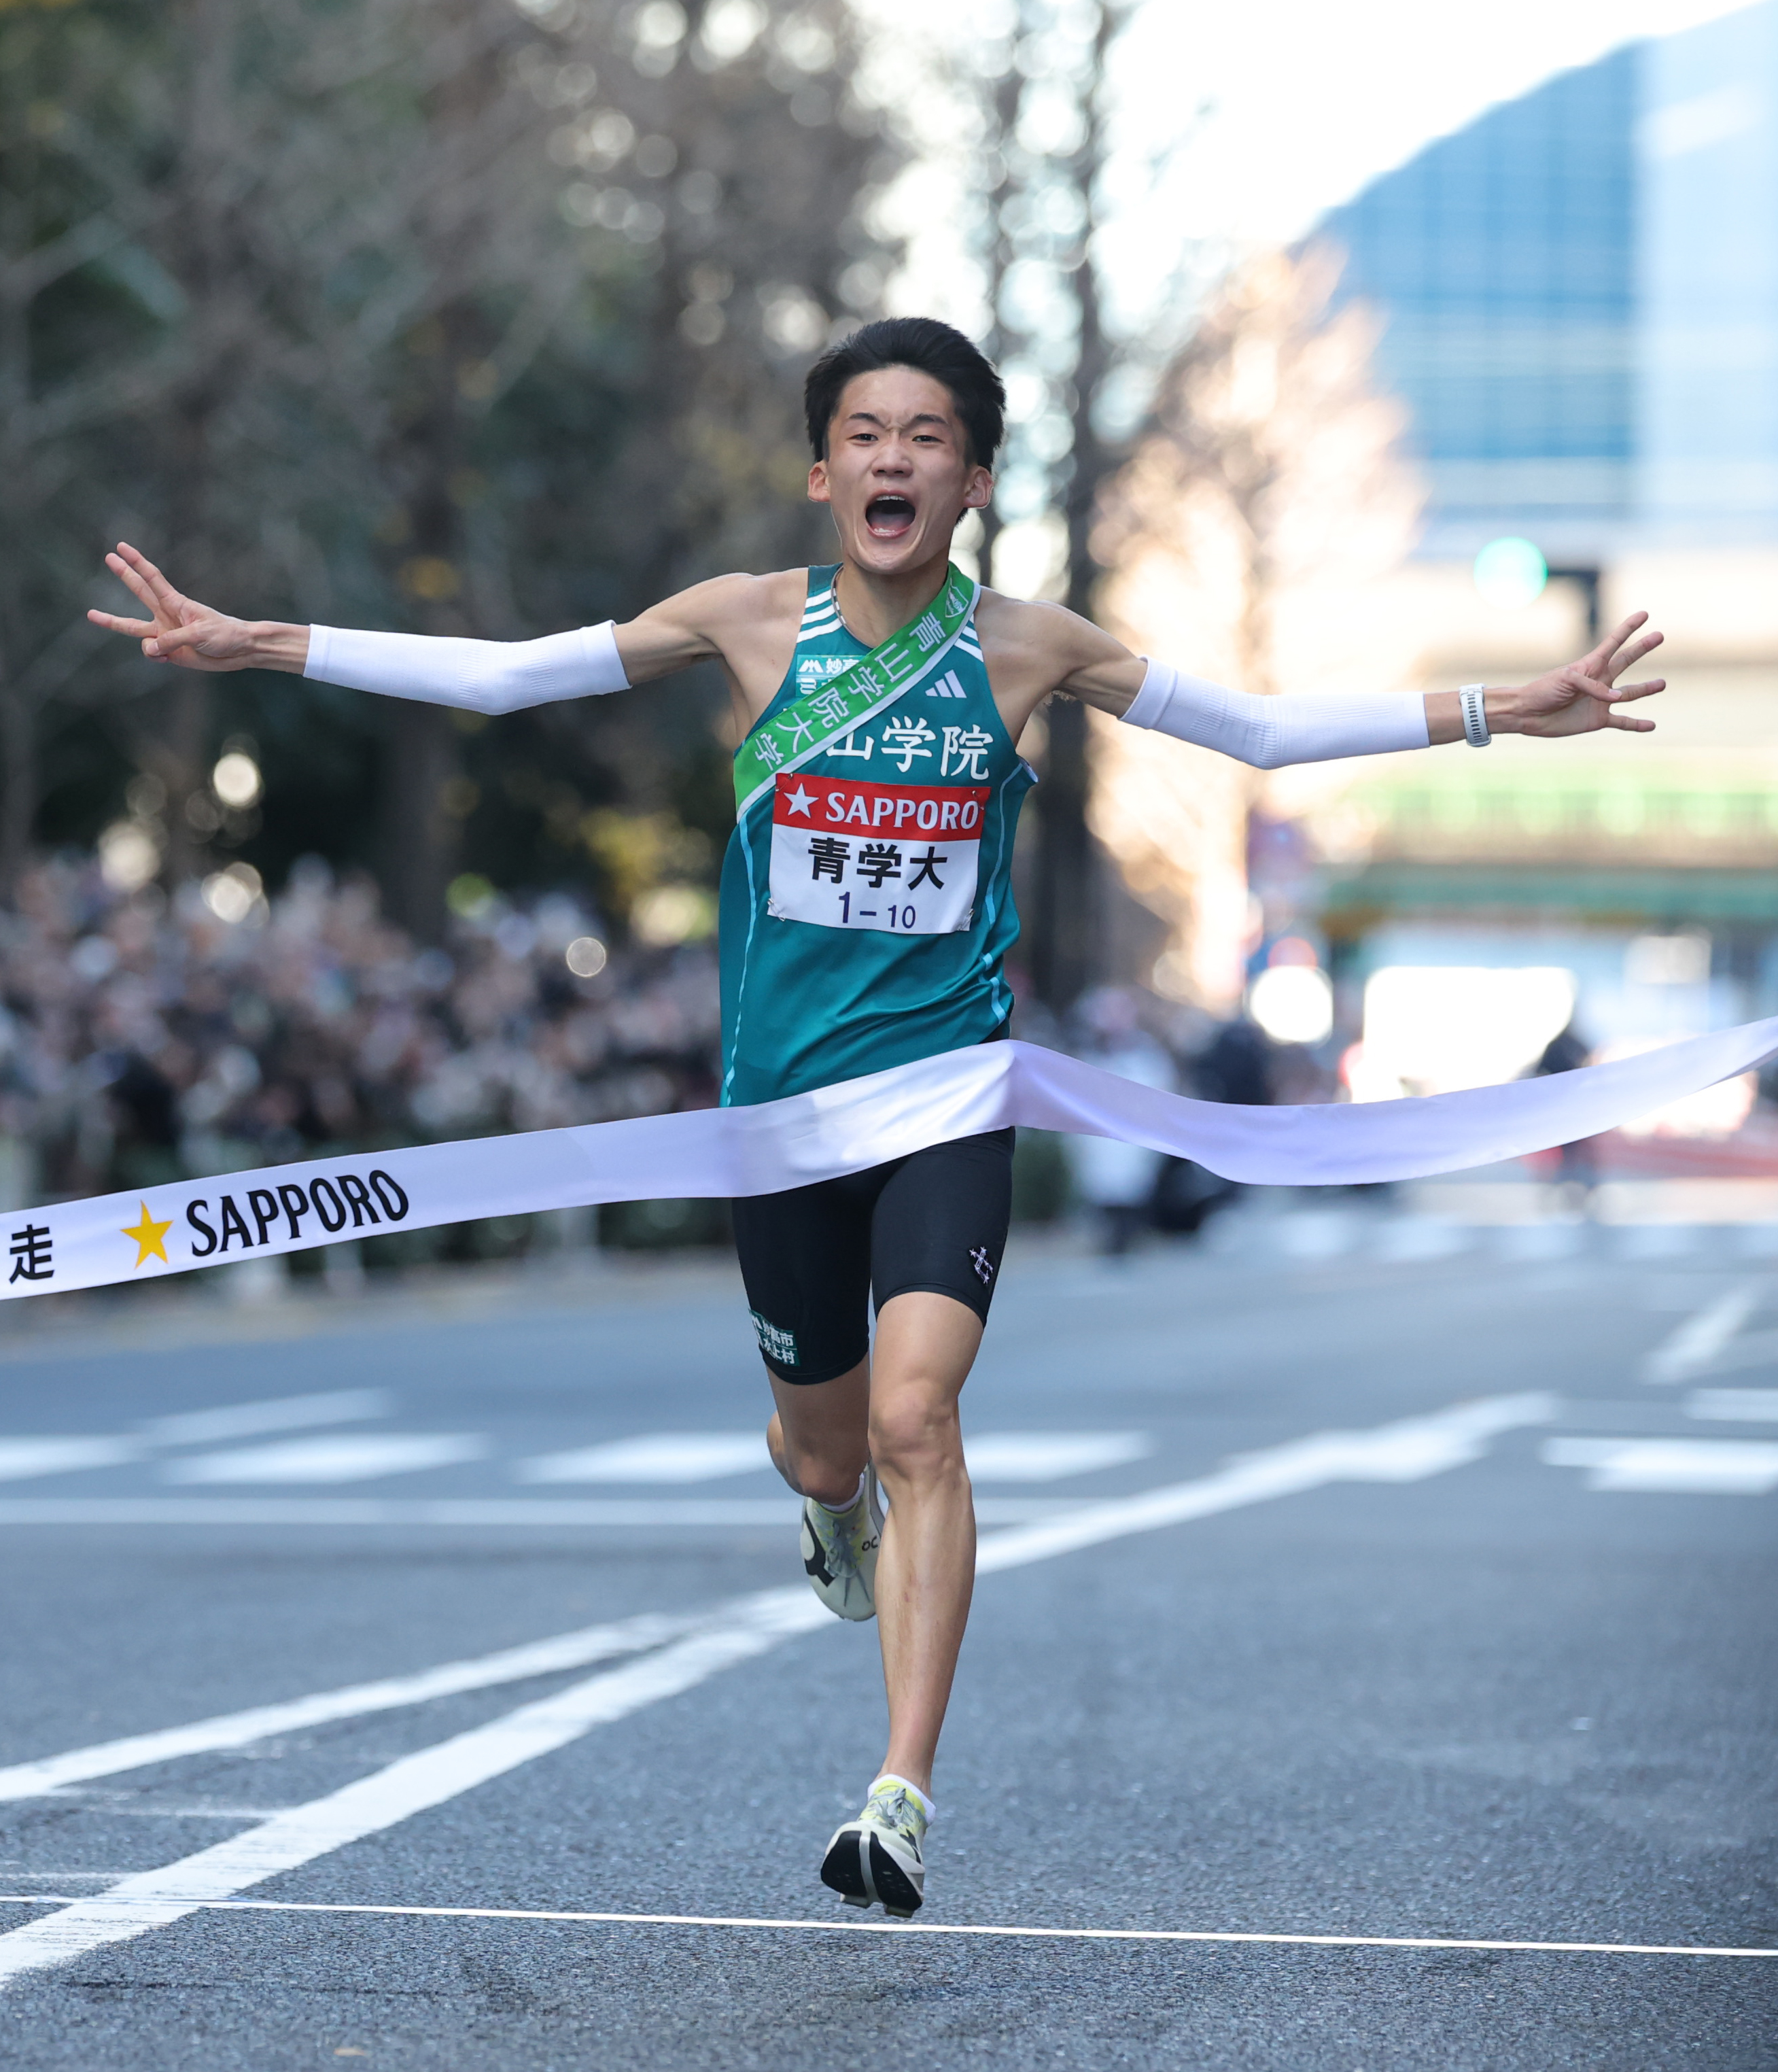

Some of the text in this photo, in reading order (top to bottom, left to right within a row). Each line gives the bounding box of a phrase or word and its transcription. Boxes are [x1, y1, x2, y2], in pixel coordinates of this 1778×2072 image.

[754, 611, 947, 772] 青山学院大学
[825, 792, 979, 830] SAPPORO
[807, 837, 948, 891] 青学大
[186, 1170, 409, 1257] SAPPORO
[9, 1224, 54, 1284] 走
